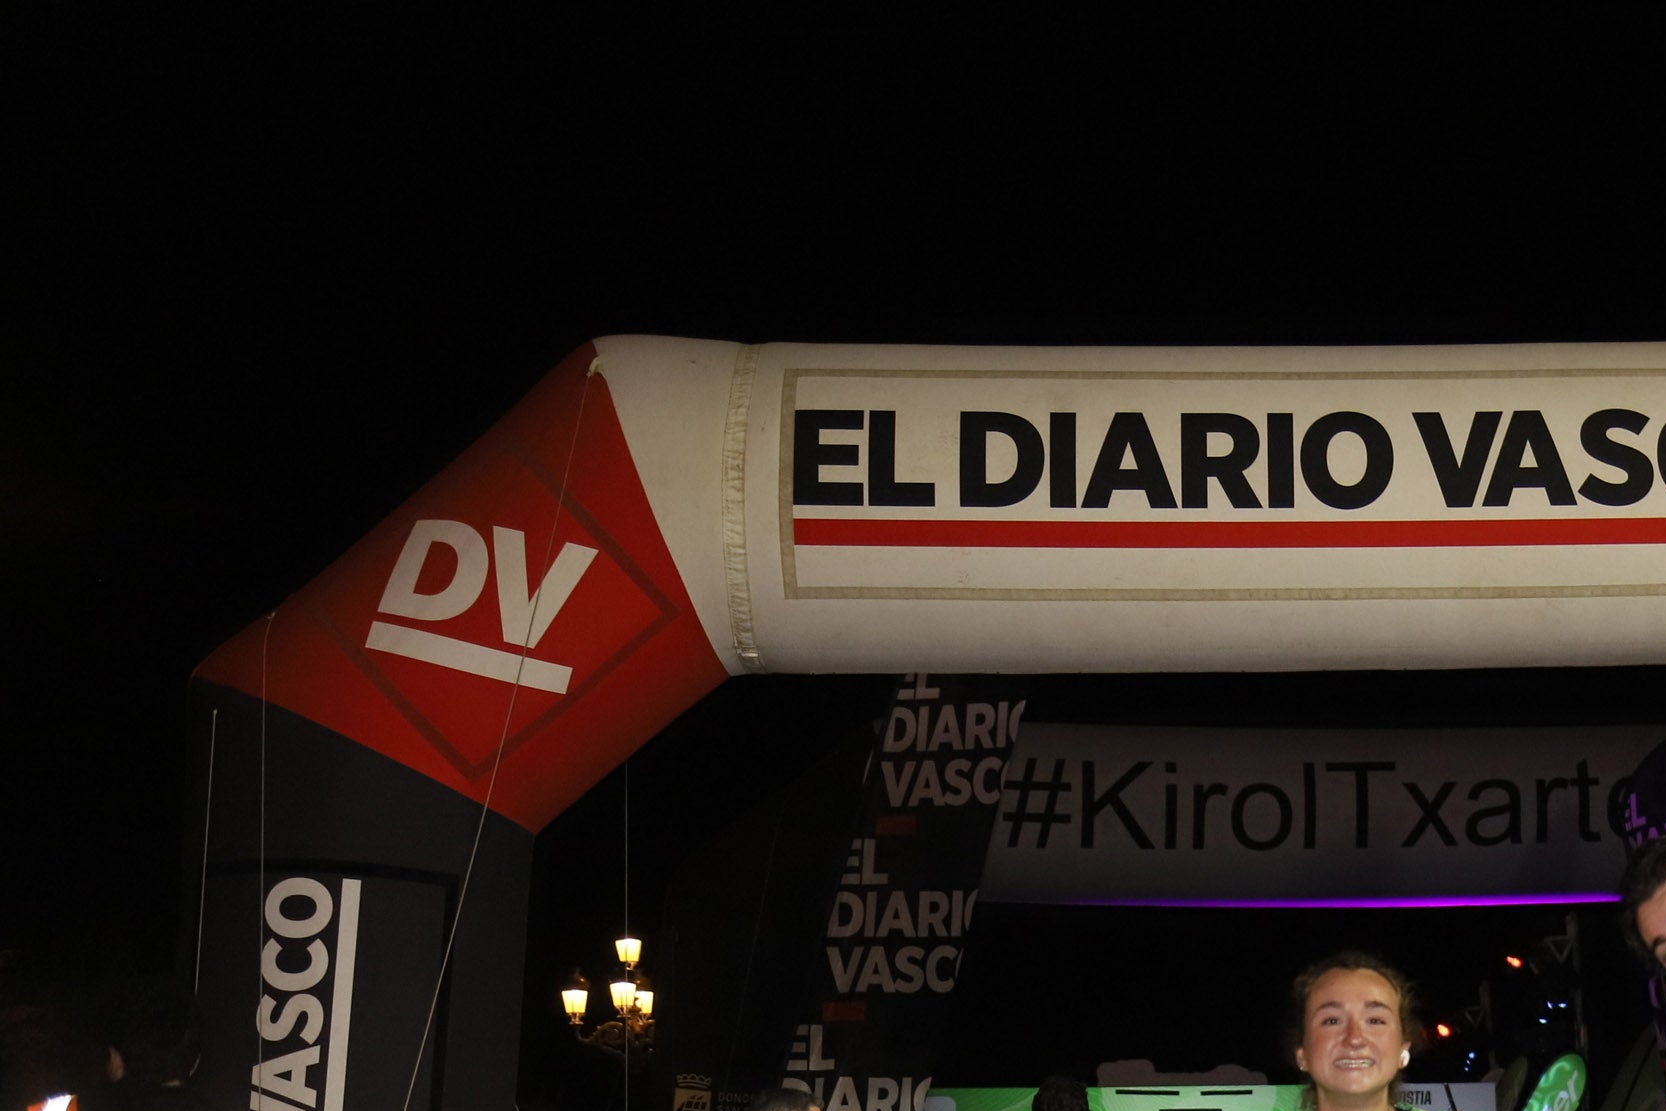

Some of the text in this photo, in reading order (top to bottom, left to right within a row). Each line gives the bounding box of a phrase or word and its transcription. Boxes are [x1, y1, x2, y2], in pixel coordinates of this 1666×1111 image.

[794, 409, 935, 507] EL
[959, 410, 1395, 510] DIARIO
[378, 519, 599, 649] DV
[880, 756, 1009, 808] VASC
[825, 946, 966, 995] VASC
